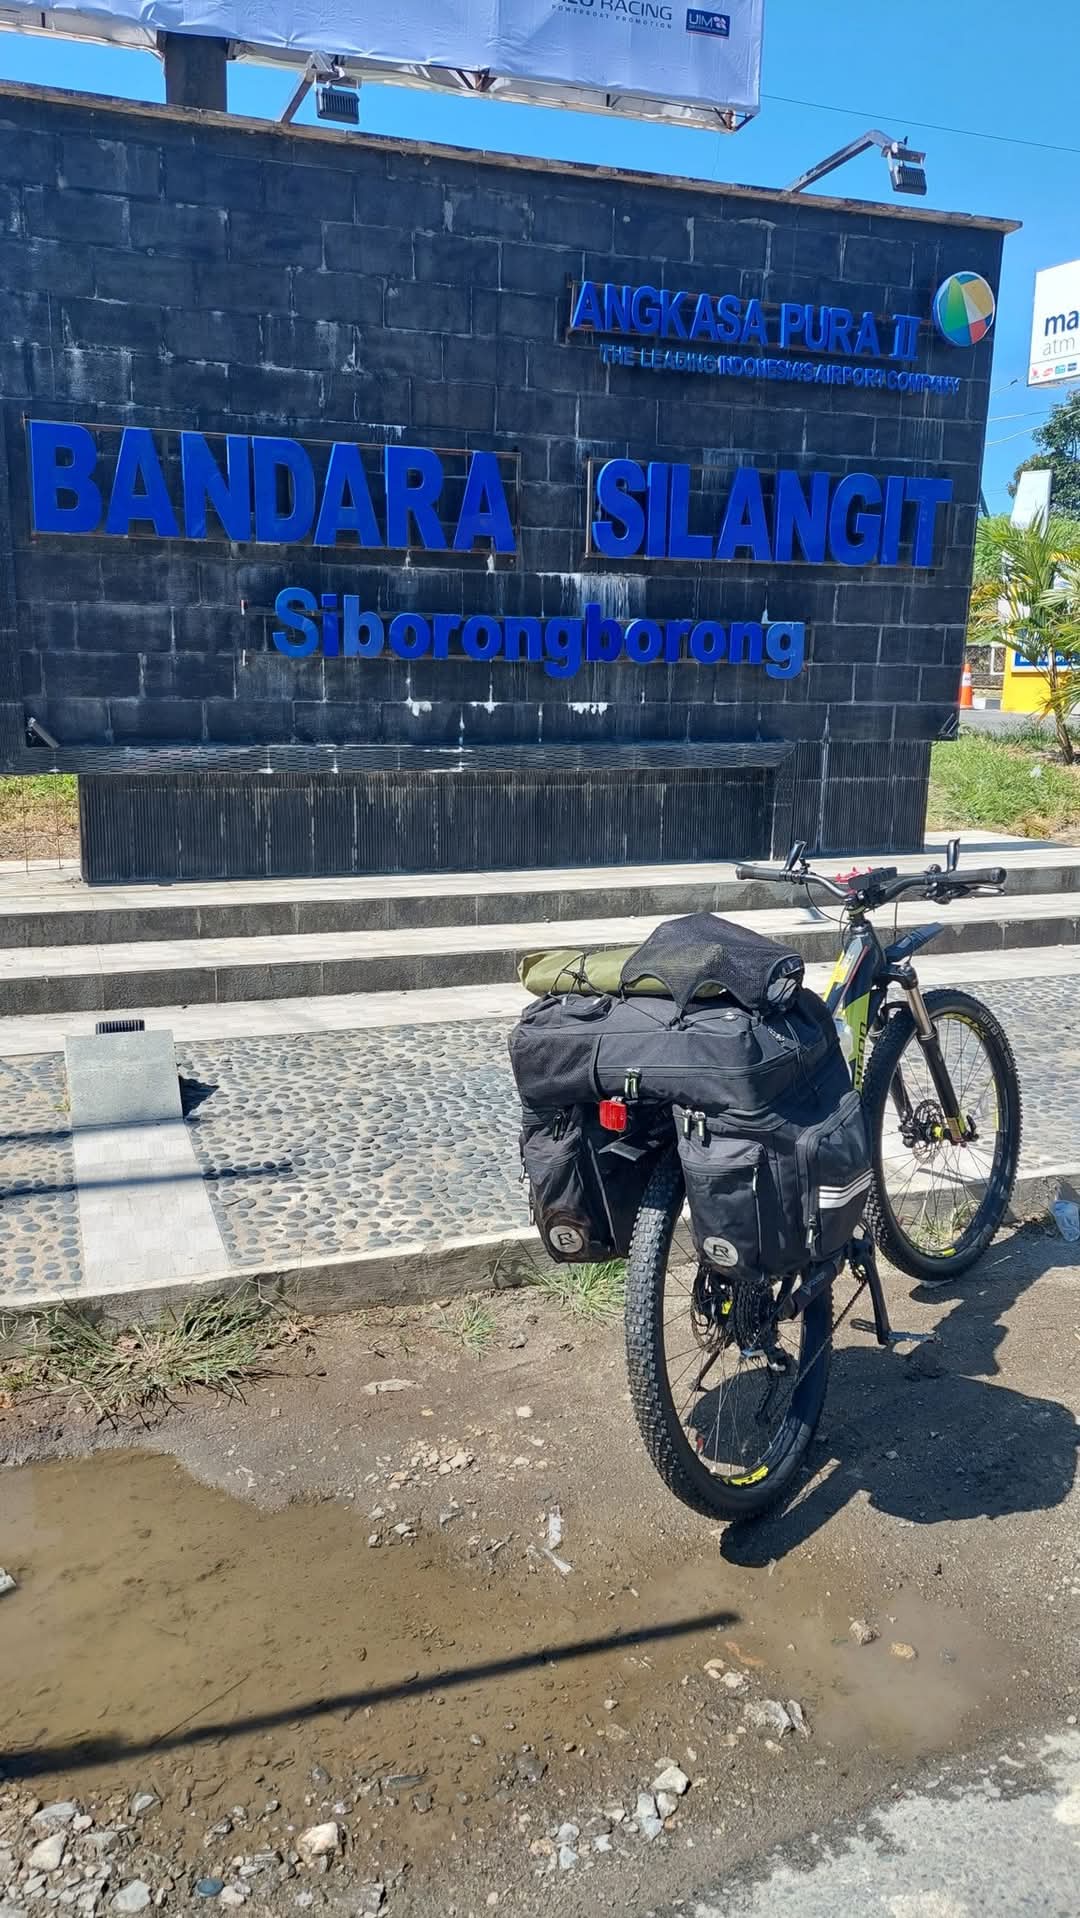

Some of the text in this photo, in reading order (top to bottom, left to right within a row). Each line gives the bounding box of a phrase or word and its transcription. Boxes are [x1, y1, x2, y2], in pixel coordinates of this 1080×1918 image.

[552, 4, 672, 29] POWERBOAT PROMOTION
[601, 0, 672, 21] RACING
[570, 281, 922, 361] ANGKASA PURA II
[1044, 310, 1079, 337] ma
[1042, 337, 1075, 356] atm
[600, 344, 634, 366] THE
[641, 348, 718, 374] LEADING
[815, 363, 886, 388] AIRPORT
[887, 370, 962, 394] COMPANY
[29, 420, 954, 567] BANDARA SILANGIT
[272, 587, 806, 680] Siborongborong
